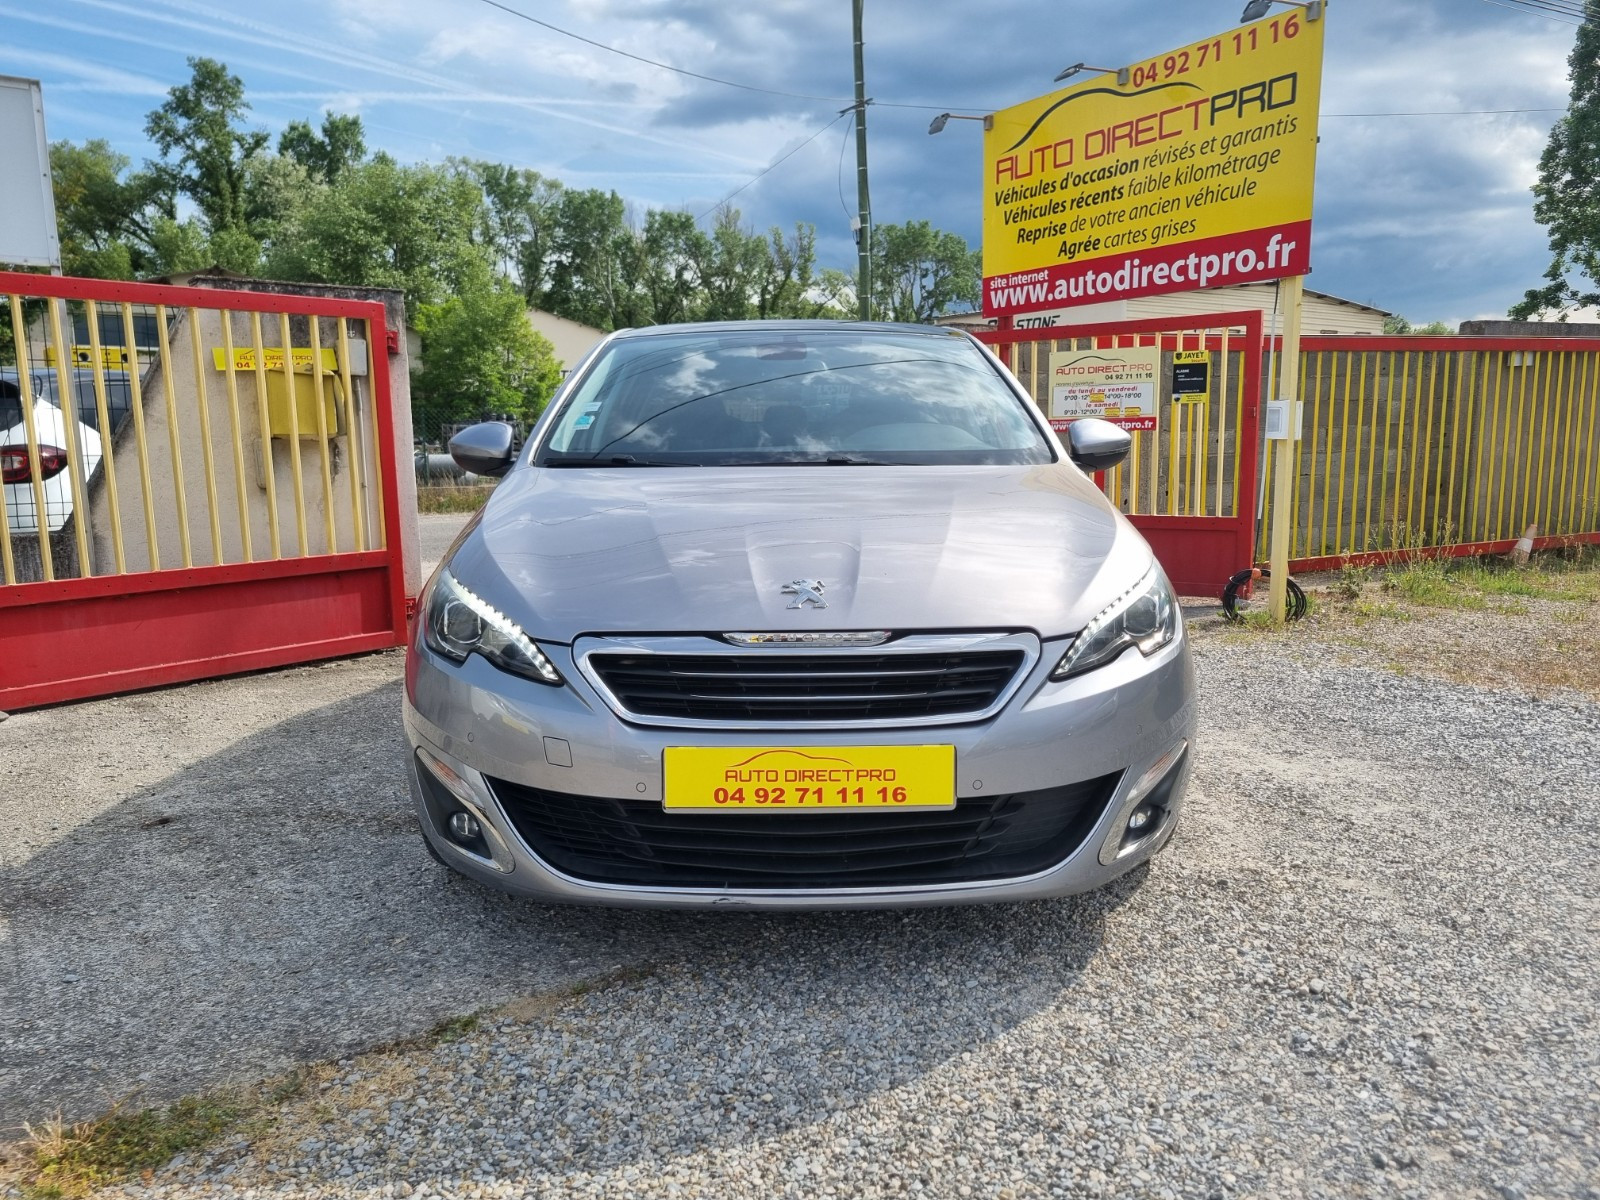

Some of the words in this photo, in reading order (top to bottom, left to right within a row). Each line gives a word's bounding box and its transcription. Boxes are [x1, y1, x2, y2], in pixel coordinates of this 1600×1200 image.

[1132, 61, 1158, 88] 04
[1163, 51, 1190, 79] 92
[1197, 39, 1221, 68] 71
[1232, 27, 1257, 56] 11
[1269, 13, 1299, 44] 16
[994, 178, 1057, 207] Véhicules
[1060, 158, 1139, 190] d'occasion
[1142, 140, 1196, 169] révisés
[1200, 135, 1217, 155] et
[1219, 114, 1298, 155] garantis
[996, 138, 1074, 185] AUTO
[1004, 198, 1067, 225] Véhicules
[1069, 184, 1125, 210] récents
[1127, 171, 1171, 198] faible
[1174, 148, 1281, 187] kilométrage
[1017, 221, 1067, 245] Reprise
[1069, 214, 1087, 233] de
[1090, 209, 1126, 229] votre
[1128, 196, 1181, 221] ancien
[1185, 177, 1257, 209] véhicule
[1057, 235, 1101, 260] Agrée
[1103, 227, 1148, 249] cartes
[1150, 218, 1197, 244] grises
[990, 233, 1296, 309] www.autodirectpro.fr
[990, 276, 1007, 290] site
[1008, 268, 1049, 286] internet
[1056, 366, 1085, 376] AUTO
[1087, 364, 1128, 374] DIRECT
[1129, 363, 1153, 371] PRO
[1183, 351, 1205, 359] JAYET
[713, 787, 746, 804] 04
[754, 787, 786, 804] 92
[794, 787, 824, 804] 71
[836, 786, 865, 803] 11
[876, 786, 907, 803] 16
[724, 770, 779, 783] AUTO
